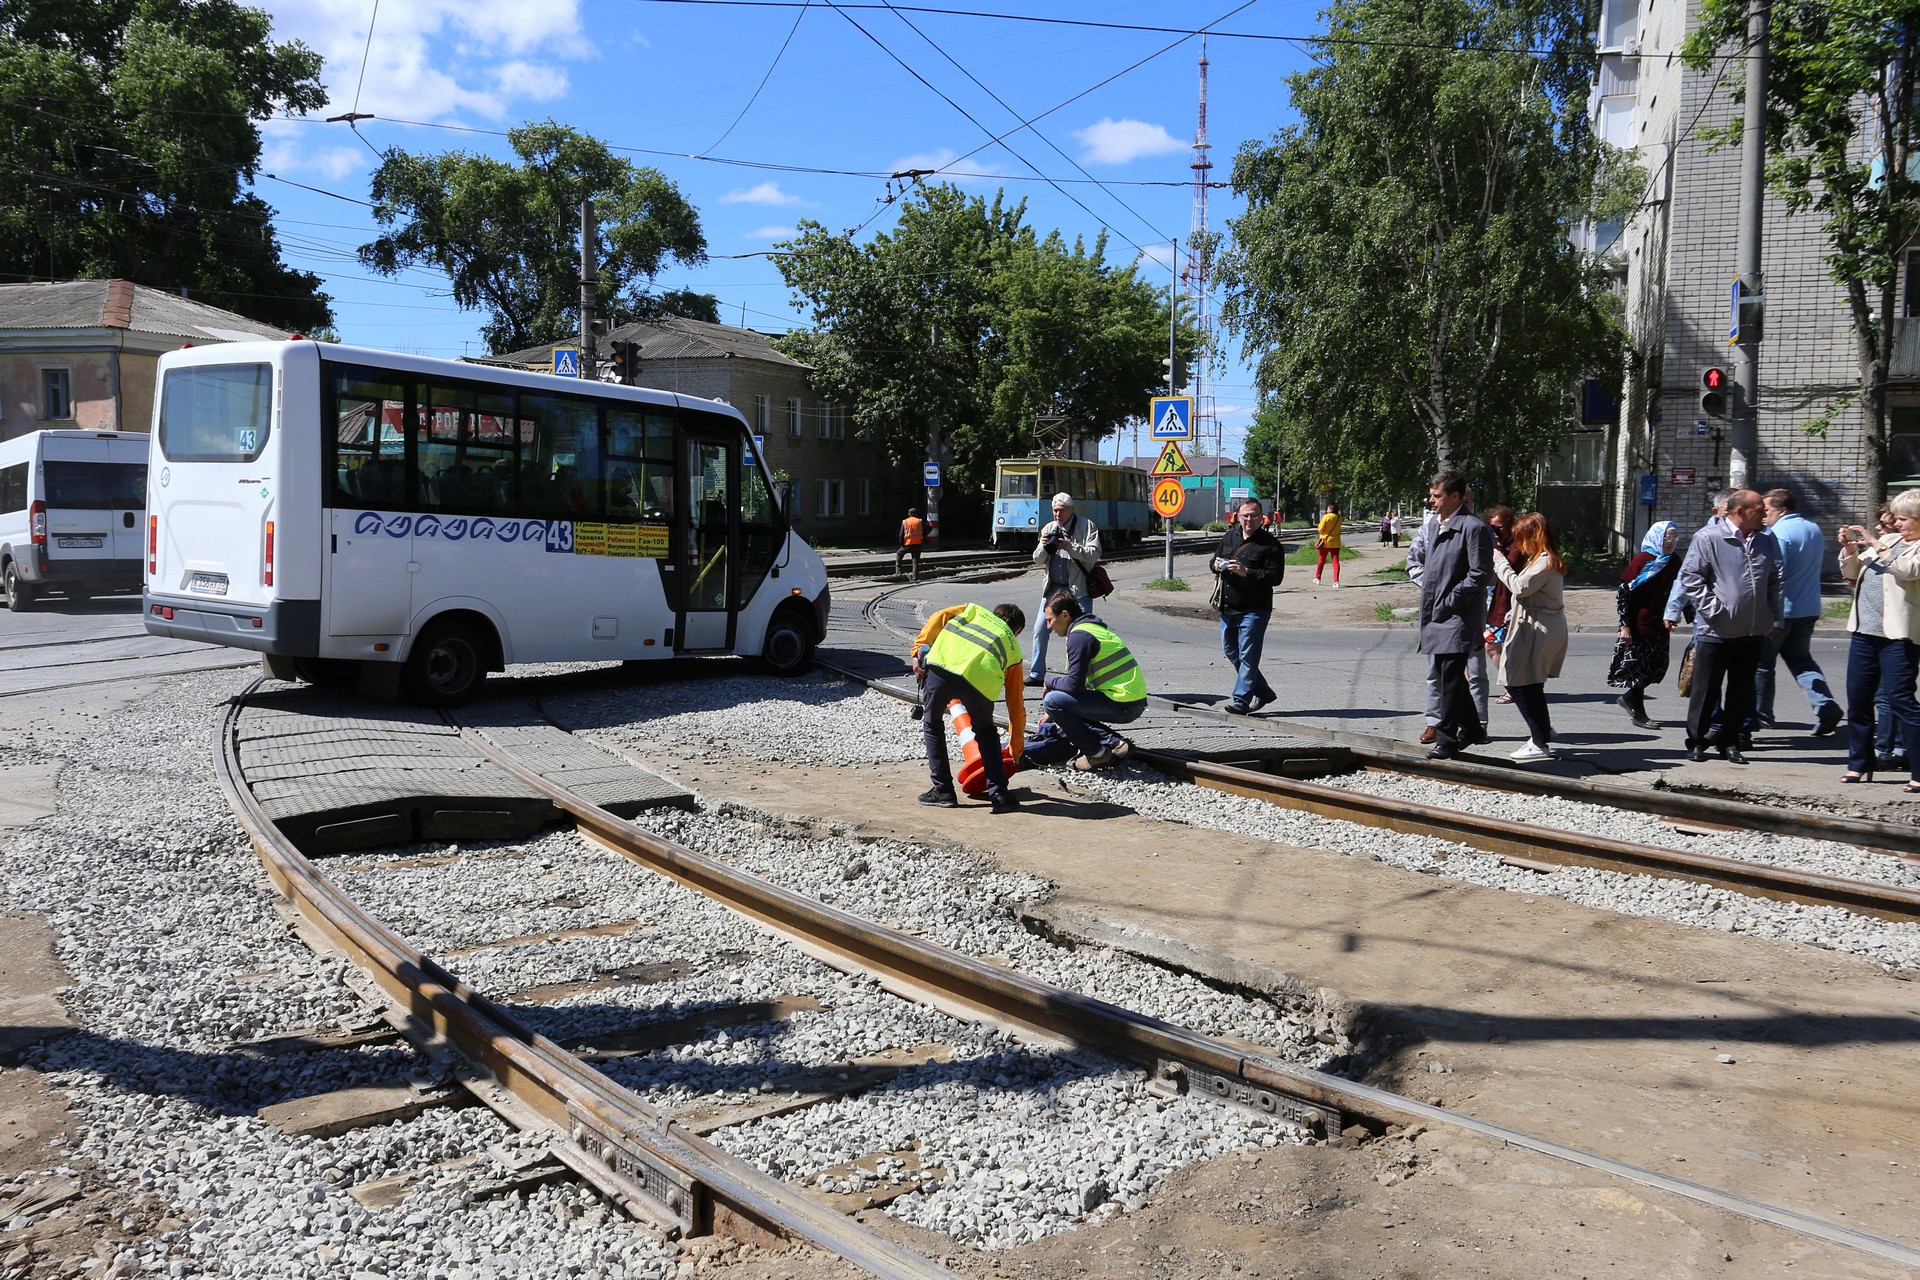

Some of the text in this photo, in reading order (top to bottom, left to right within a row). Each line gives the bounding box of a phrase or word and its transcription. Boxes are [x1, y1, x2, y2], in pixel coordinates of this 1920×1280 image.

[240, 430, 255, 450] 43
[1159, 489, 1179, 506] 40
[547, 520, 573, 550] 43
[606, 523, 636, 531] Октябрьская
